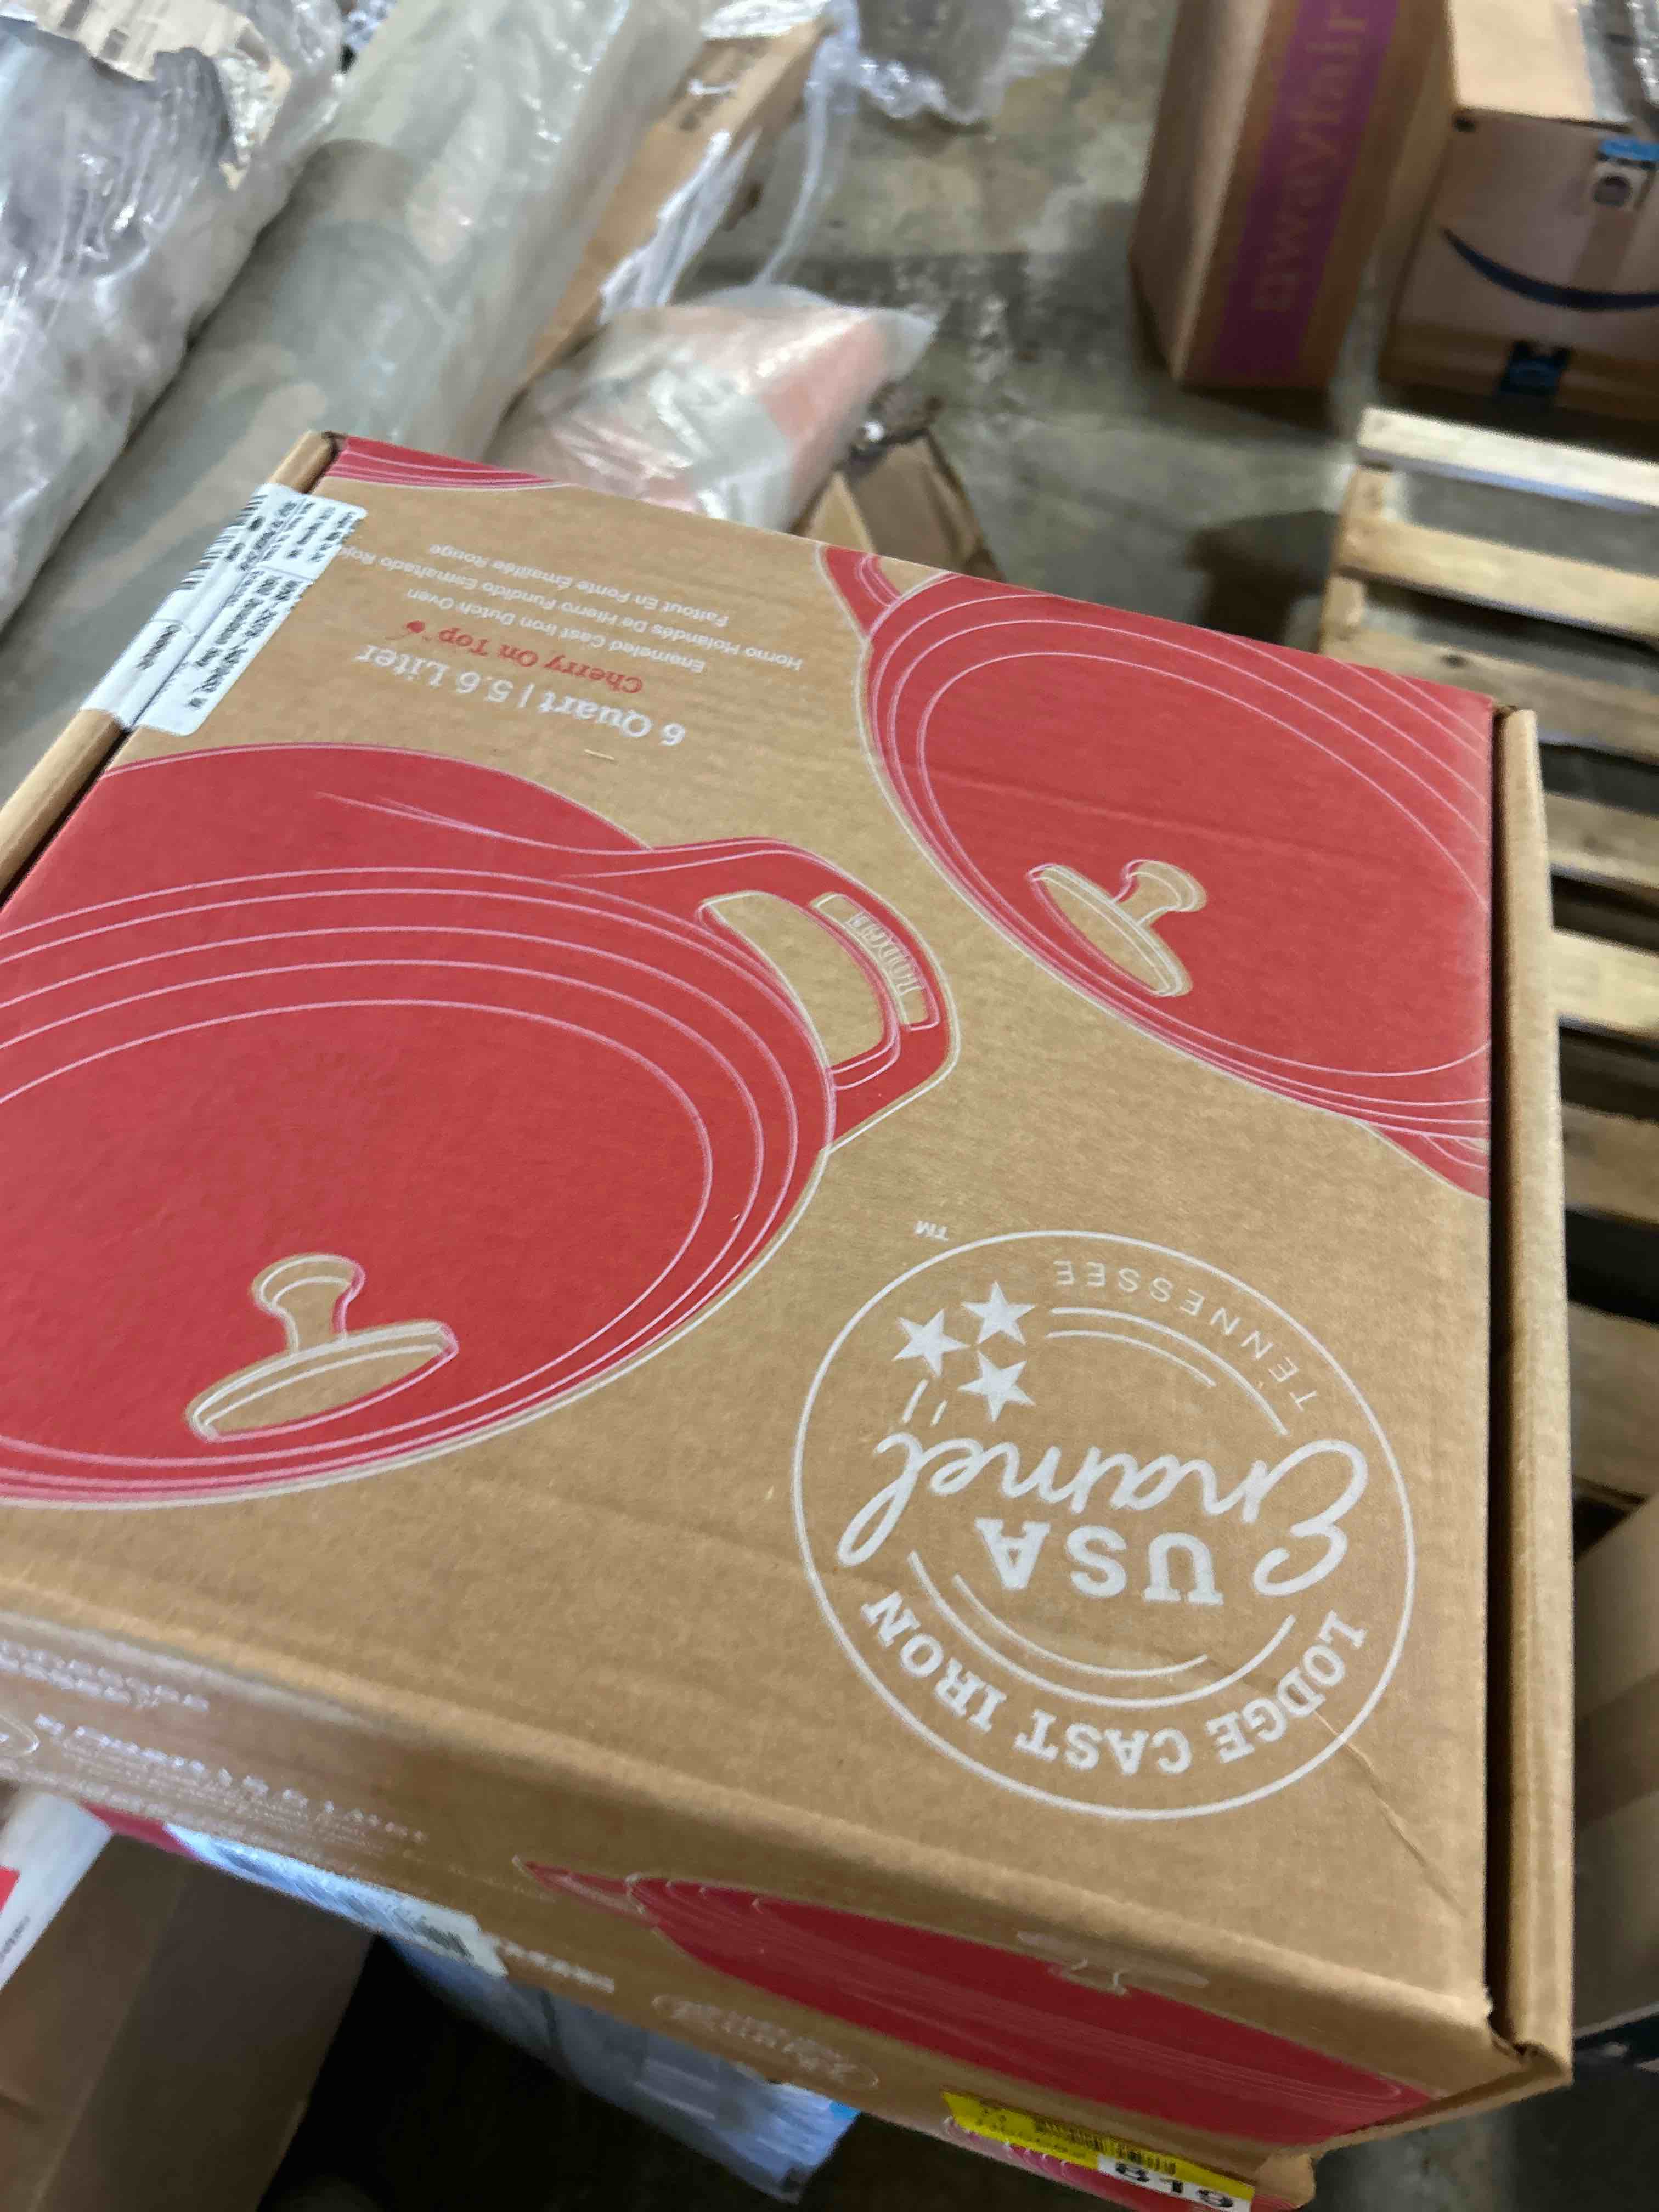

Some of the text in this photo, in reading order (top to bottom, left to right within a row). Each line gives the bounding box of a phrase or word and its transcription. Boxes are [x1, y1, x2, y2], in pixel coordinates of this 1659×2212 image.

[429, 544, 489, 567] Rouge
[482, 582, 557, 611] Fundido
[577, 582, 631, 603] Fonte
[634, 596, 659, 611] En
[561, 602, 618, 625] Hierro
[620, 618, 648, 633] De
[406, 589, 706, 673] Enameled Cast Iron Dutch Oven
[352, 645, 449, 688] Liter
[498, 645, 538, 668] On
[746, 647, 803, 670] Horno
[451, 672, 514, 703] 5.6
[544, 655, 642, 694] Cherry
[537, 691, 653, 738] Quart
[659, 723, 685, 747] 6
[1052, 1259, 1319, 1412] TENNESSEE
[837, 1431, 1369, 1597] Enamel
[975, 1516, 1223, 1607] USA
[859, 1590, 1365, 1775] LODGE CAST IRON
